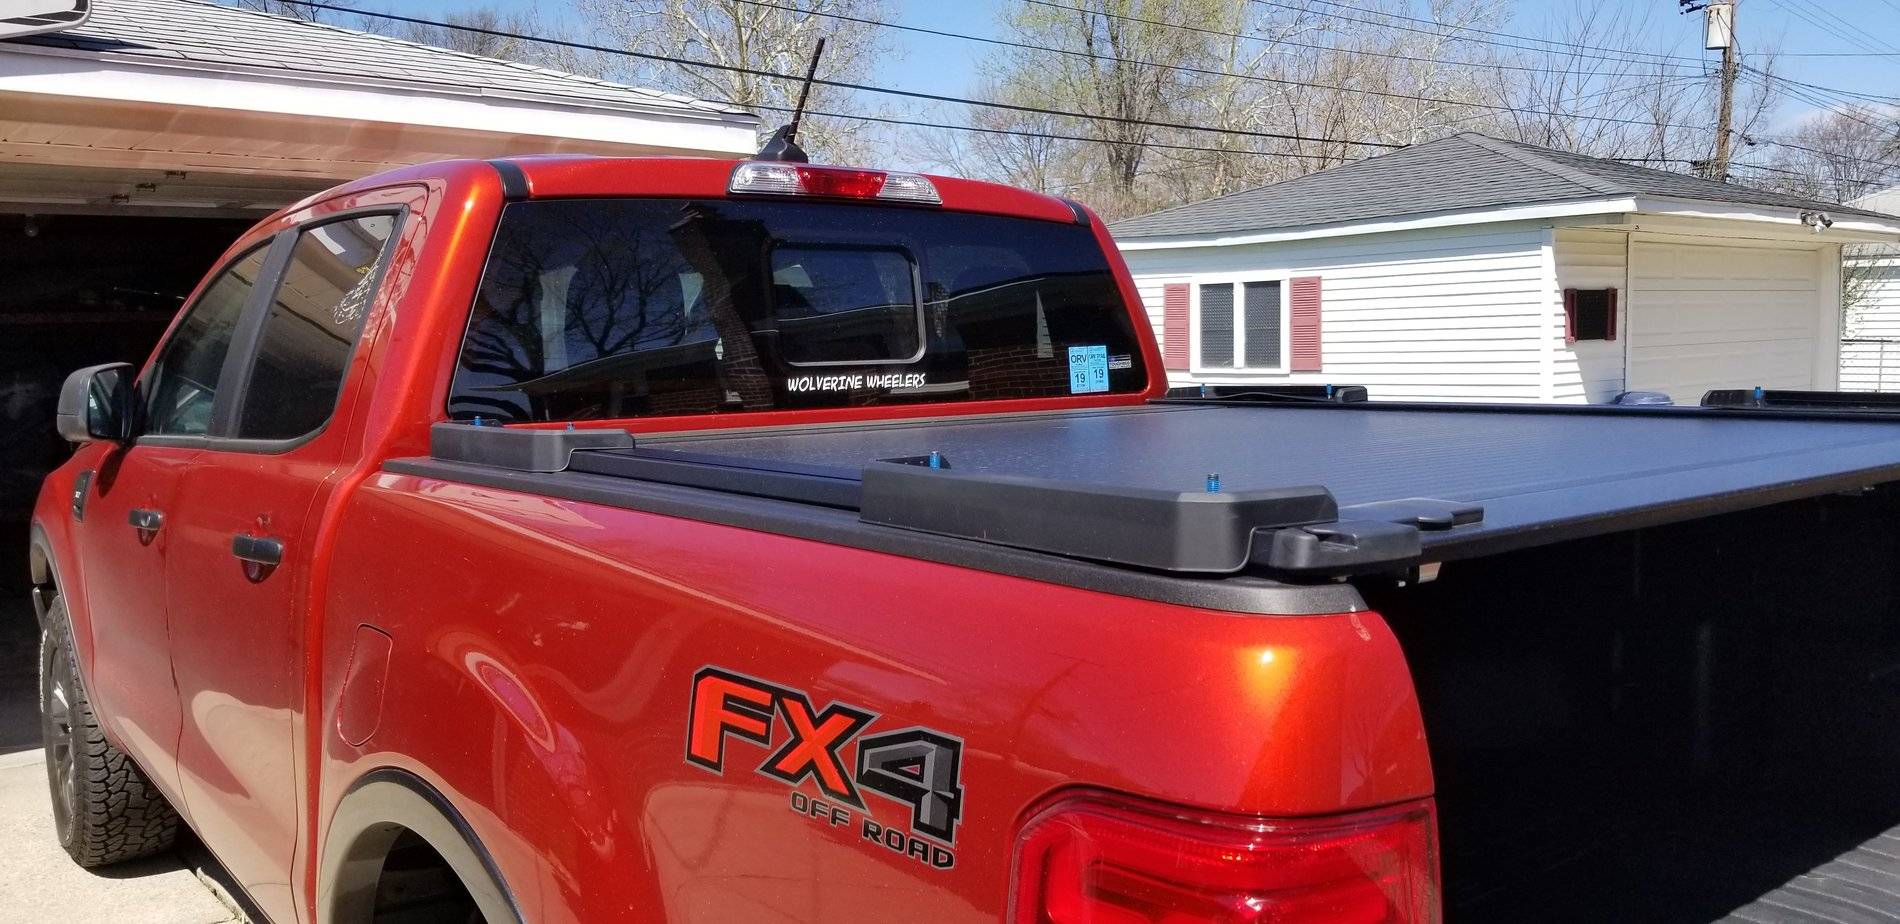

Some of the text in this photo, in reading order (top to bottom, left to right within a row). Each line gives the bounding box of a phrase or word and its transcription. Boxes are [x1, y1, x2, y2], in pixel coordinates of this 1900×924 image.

[1070, 354, 1087, 364] ORV
[1075, 373, 1086, 384] 19
[1094, 369, 1104, 379] 19
[787, 373, 926, 392] WOLVERINE WHEELERS
[685, 664, 965, 849] FX4
[790, 791, 956, 870] OFF ROAD
